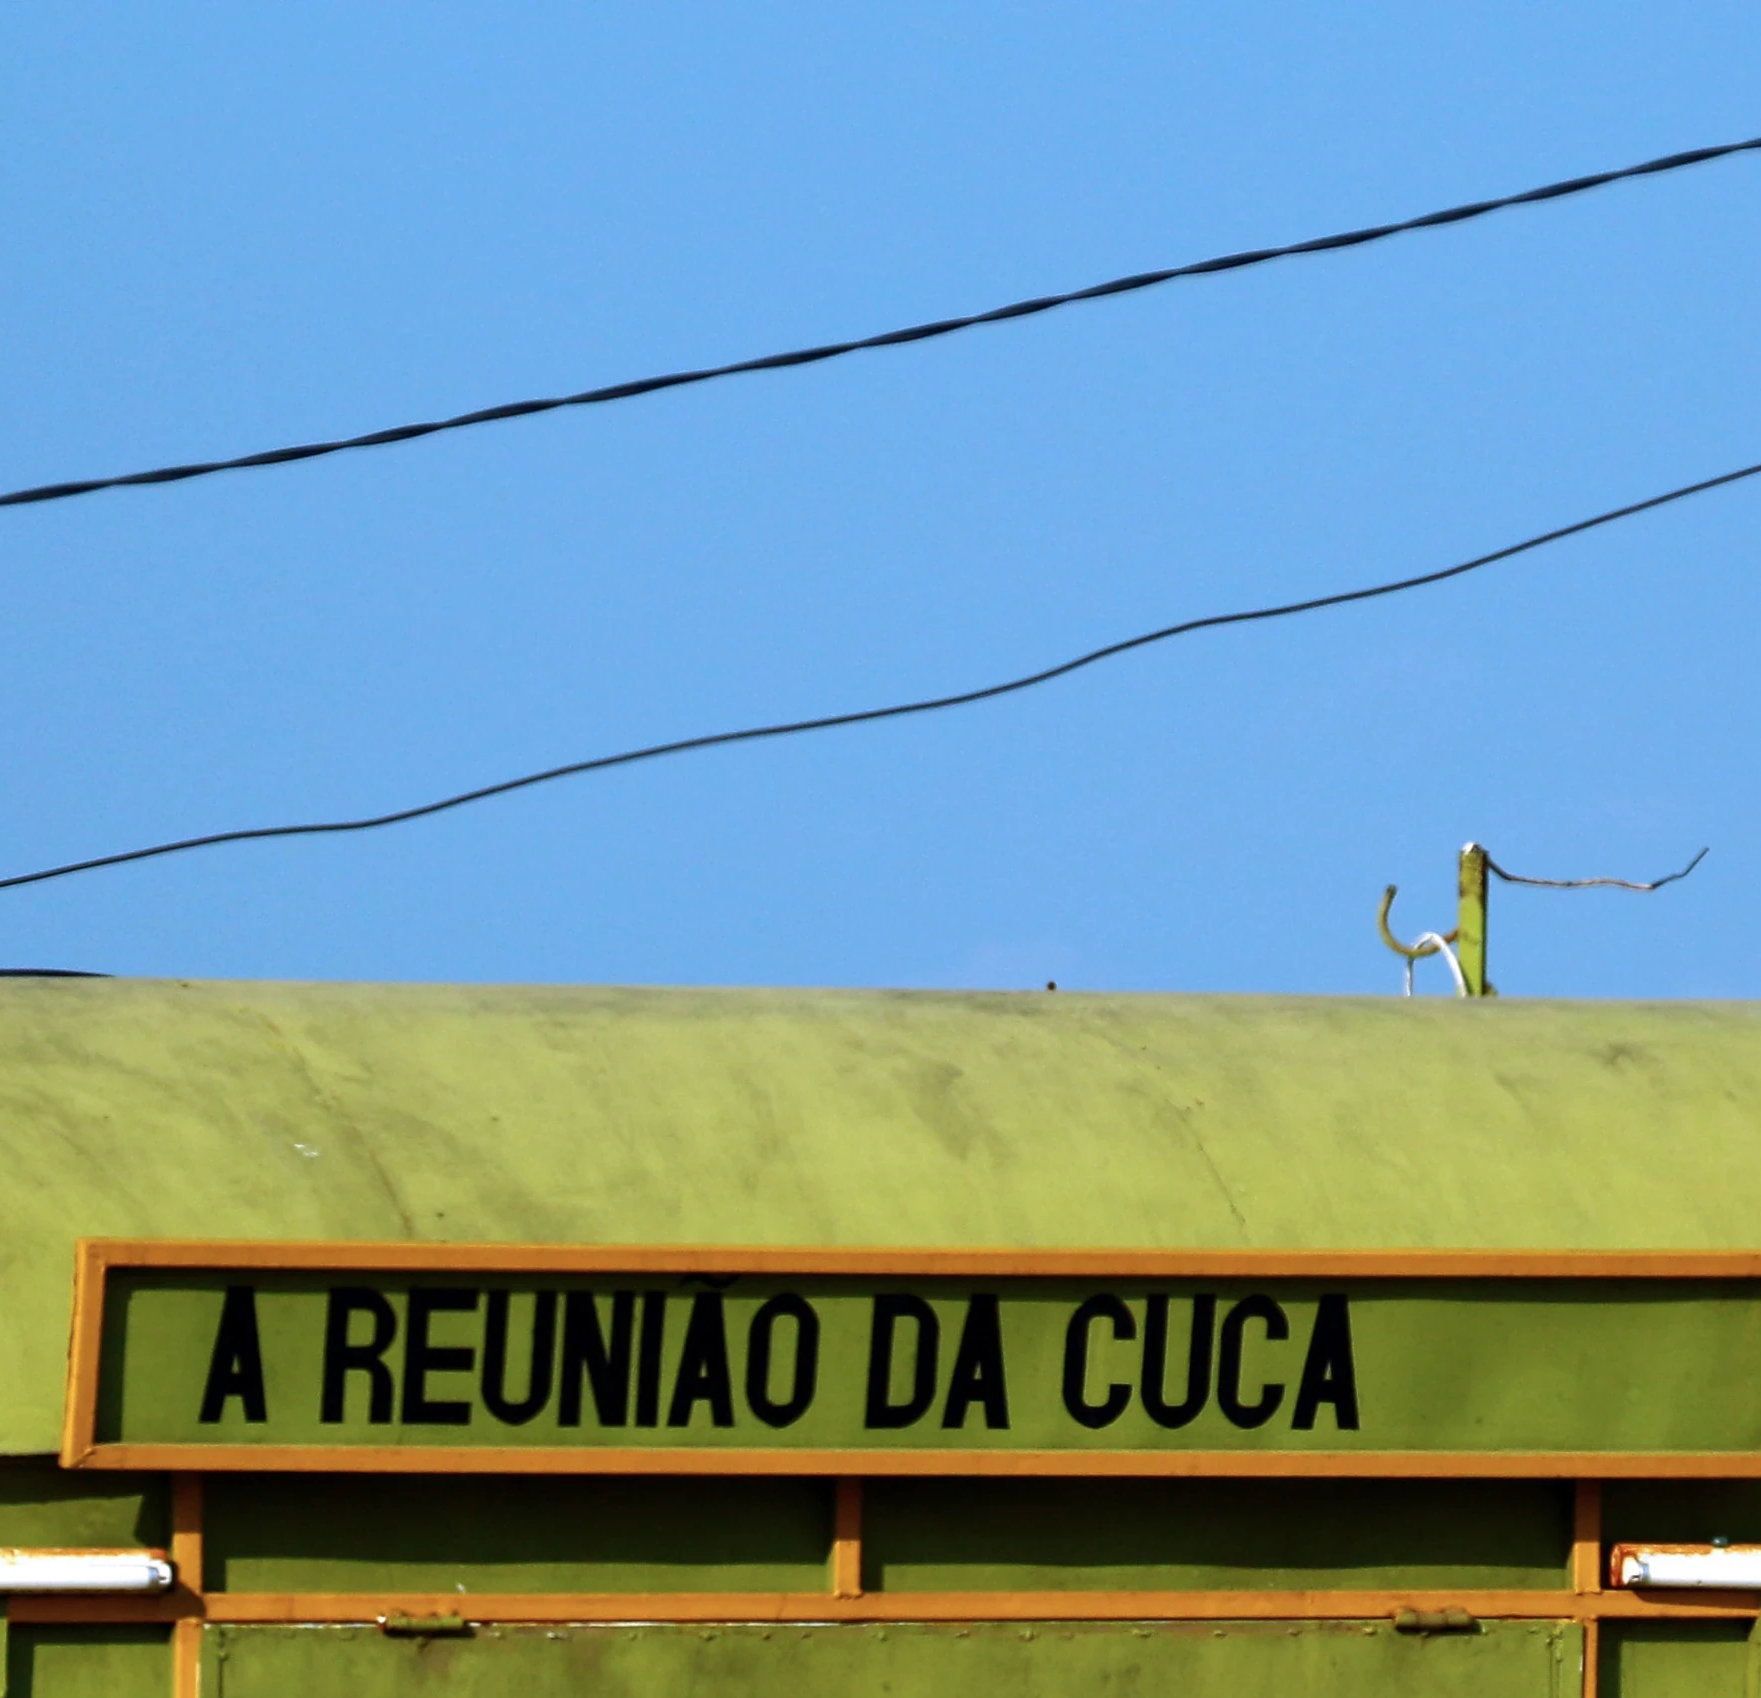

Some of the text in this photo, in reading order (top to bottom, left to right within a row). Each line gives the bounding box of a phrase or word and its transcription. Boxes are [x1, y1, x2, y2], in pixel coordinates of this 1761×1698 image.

[198, 1273, 1360, 1431] A REUNIÃO DA CUCA
